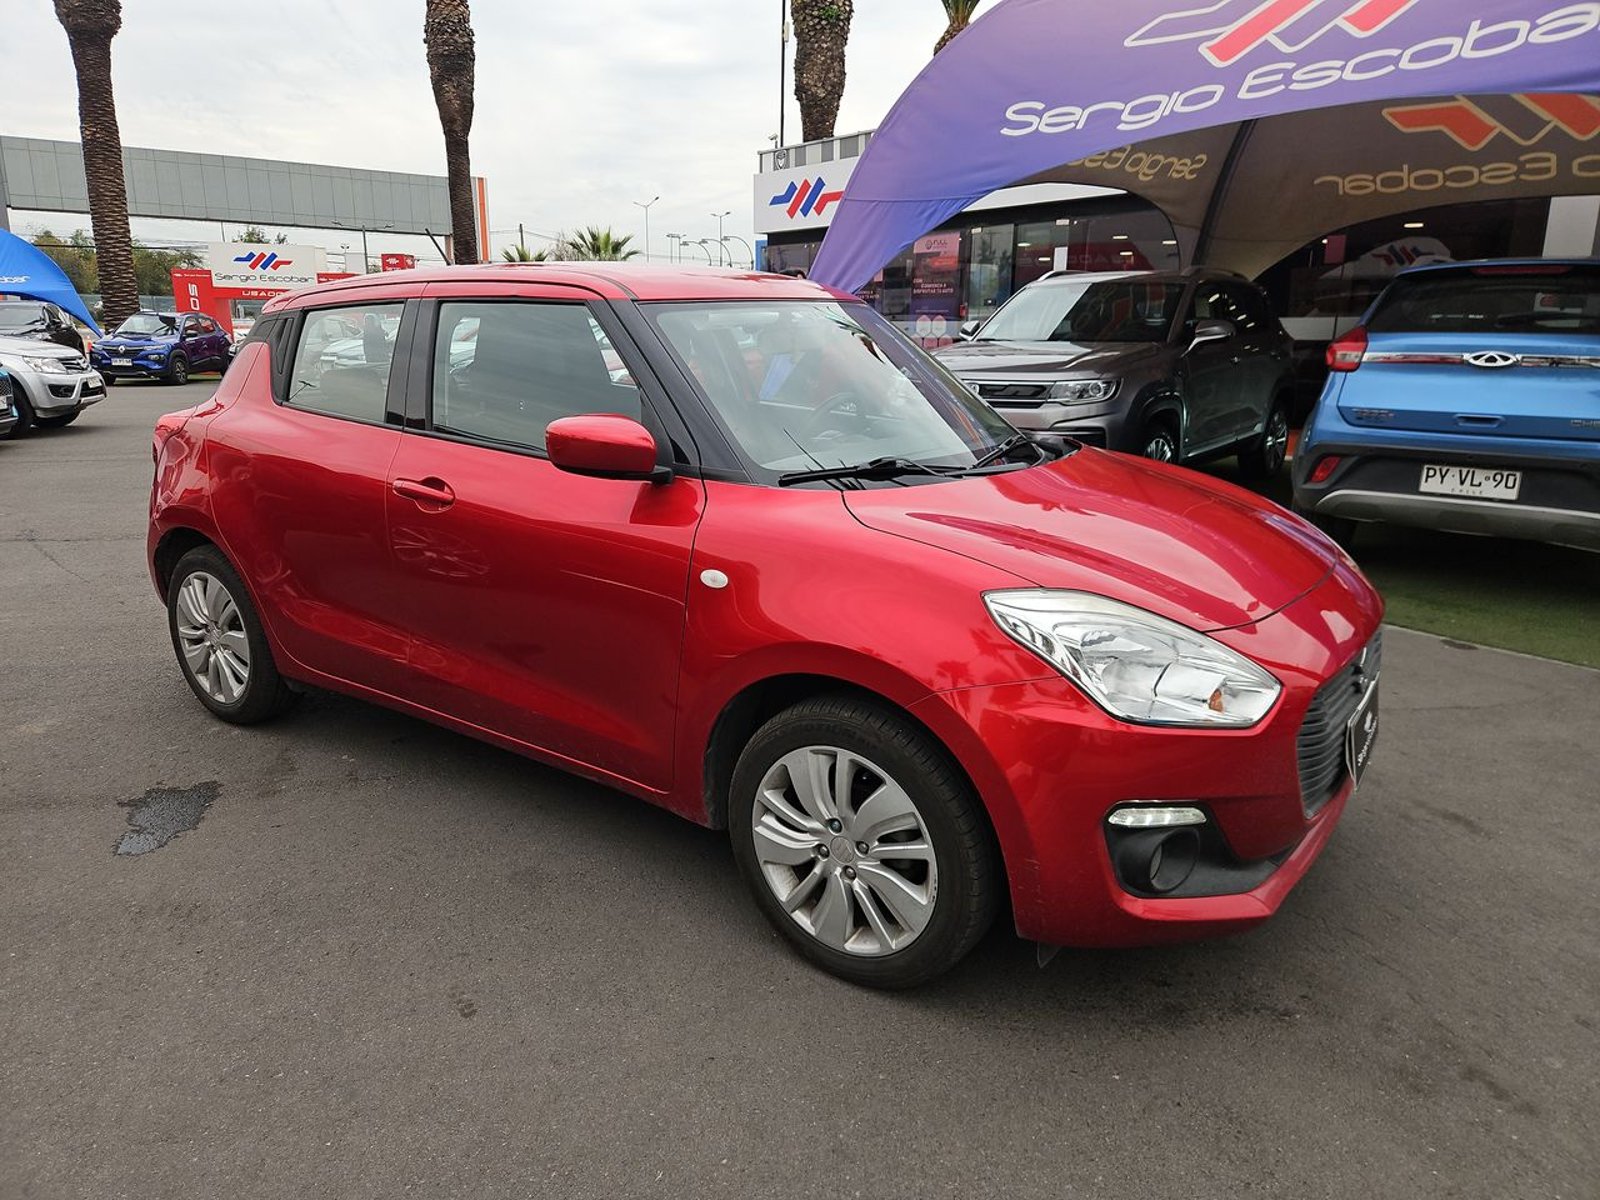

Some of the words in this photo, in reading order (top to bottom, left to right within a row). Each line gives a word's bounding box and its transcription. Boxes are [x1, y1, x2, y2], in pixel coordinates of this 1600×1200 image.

[1000, 84, 1224, 136] Sergio
[1236, 2, 1600, 100] Escoba
[214, 272, 257, 283] Sergio
[259, 274, 315, 284] Escobar
[241, 289, 286, 297] USADO
